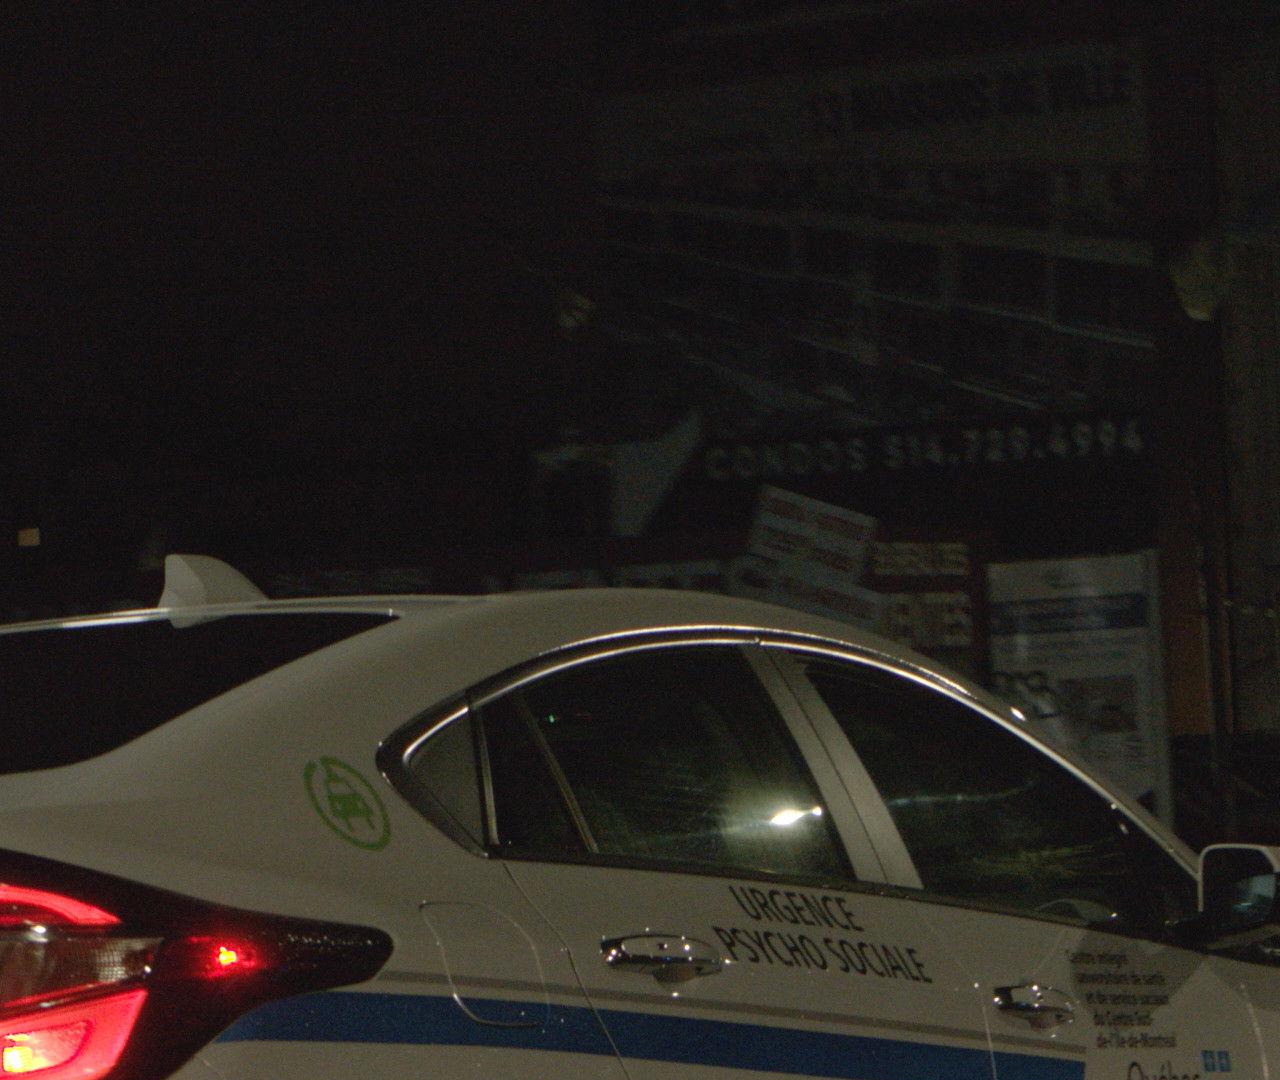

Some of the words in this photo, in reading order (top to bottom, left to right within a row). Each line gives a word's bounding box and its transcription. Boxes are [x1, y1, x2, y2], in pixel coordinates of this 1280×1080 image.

[704, 436, 867, 481] CONDOS
[727, 885, 865, 933] URGENCE
[712, 925, 827, 972] PSYCHO
[824, 938, 933, 984] SOCIALE
